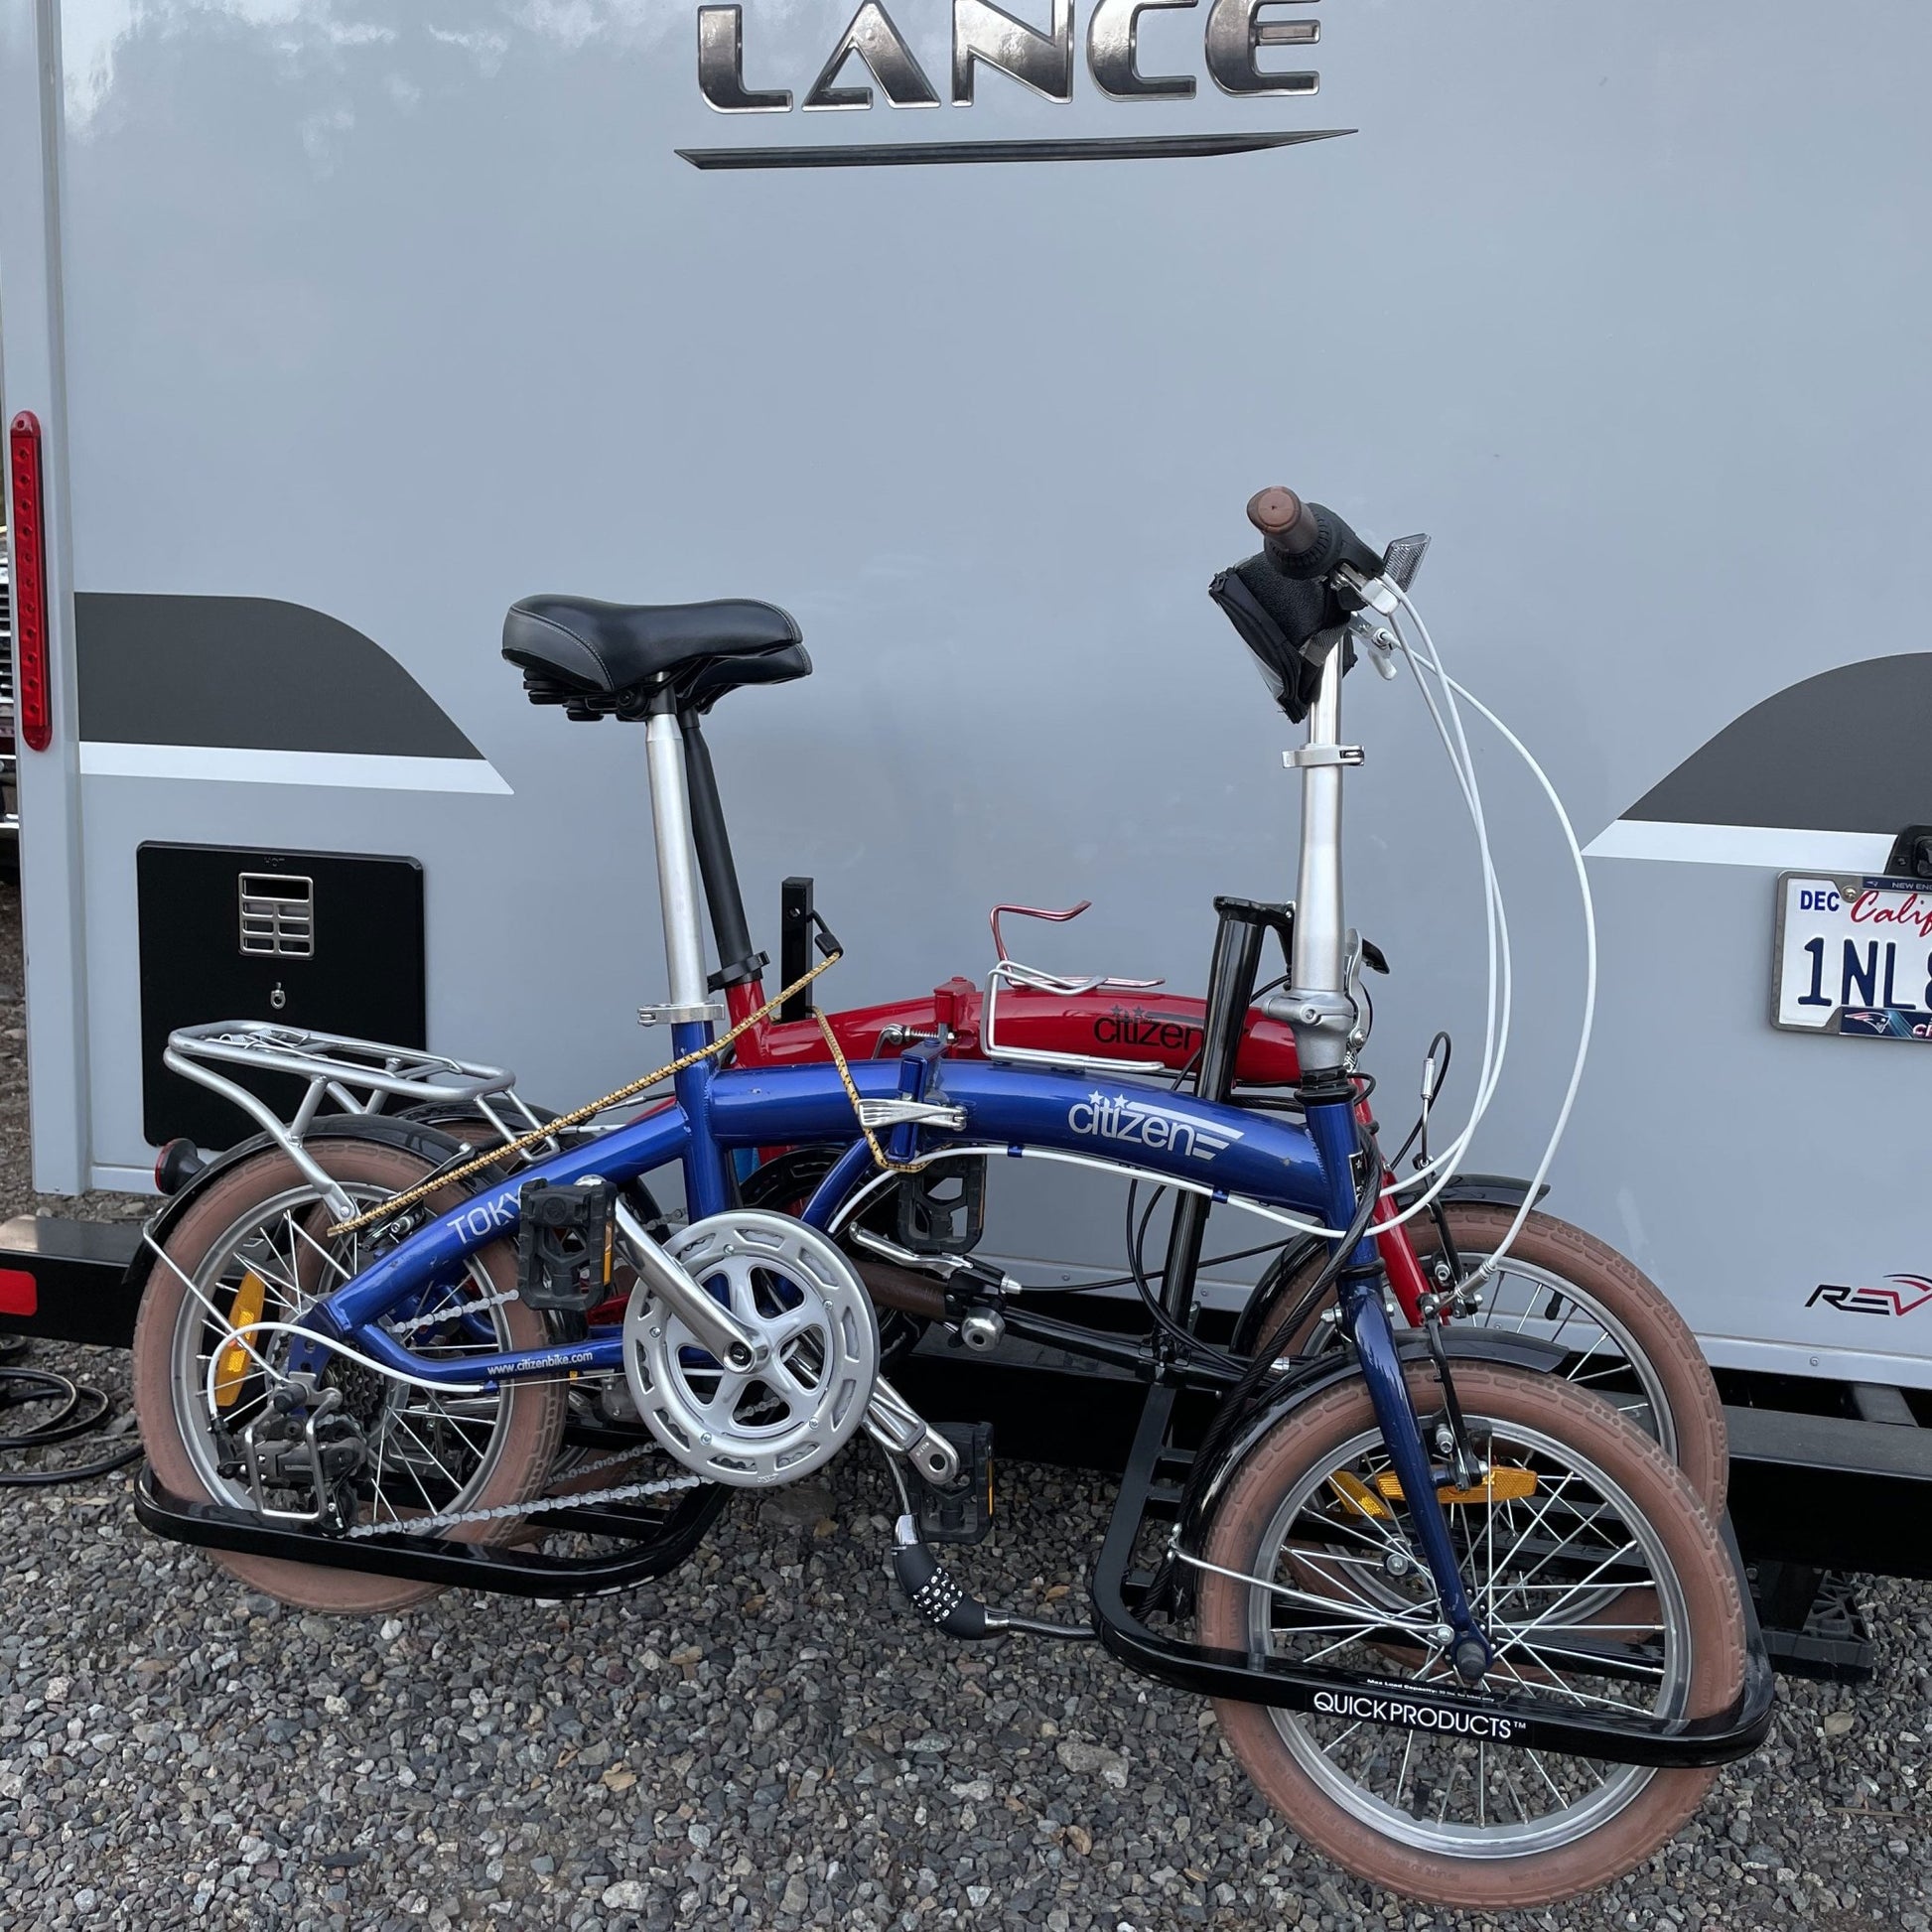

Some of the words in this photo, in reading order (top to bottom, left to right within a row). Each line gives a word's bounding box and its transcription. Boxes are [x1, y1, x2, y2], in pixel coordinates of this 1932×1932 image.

[698, 0, 1321, 114] LANCE
[1800, 890, 1840, 911] DEC
[1798, 937, 1932, 1011] 1NL
[1068, 1090, 1196, 1157] citizen
[446, 1179, 534, 1245] TOKY
[487, 1351, 593, 1375] www.citizenbike.com
